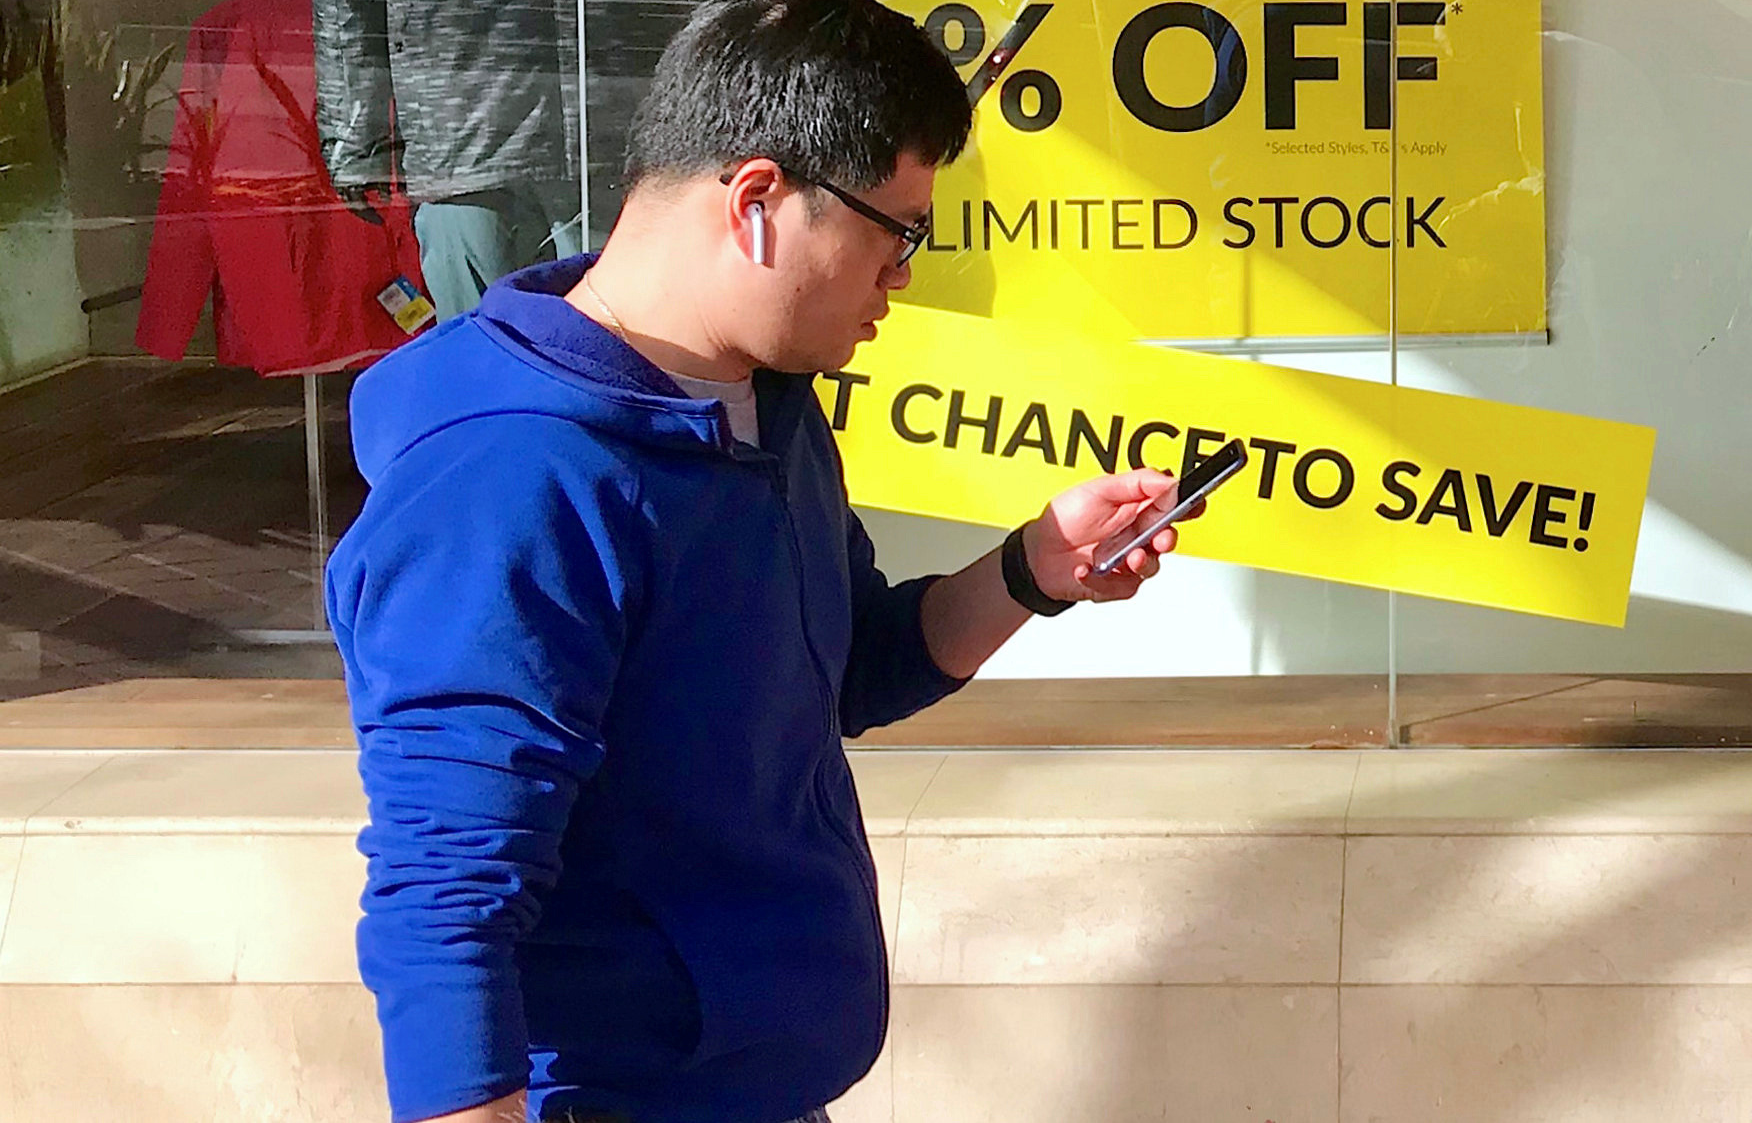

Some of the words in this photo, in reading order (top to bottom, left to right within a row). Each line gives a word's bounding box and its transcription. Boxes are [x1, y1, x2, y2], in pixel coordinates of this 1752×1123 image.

[924, 2, 1063, 133] %
[1328, 141, 1369, 156] Styles,
[1410, 141, 1448, 156] Apply
[926, 197, 1198, 251] LIMITED
[1222, 196, 1448, 250] STOCK
[1249, 436, 1355, 510] TO
[1375, 460, 1596, 553] SAVE!
